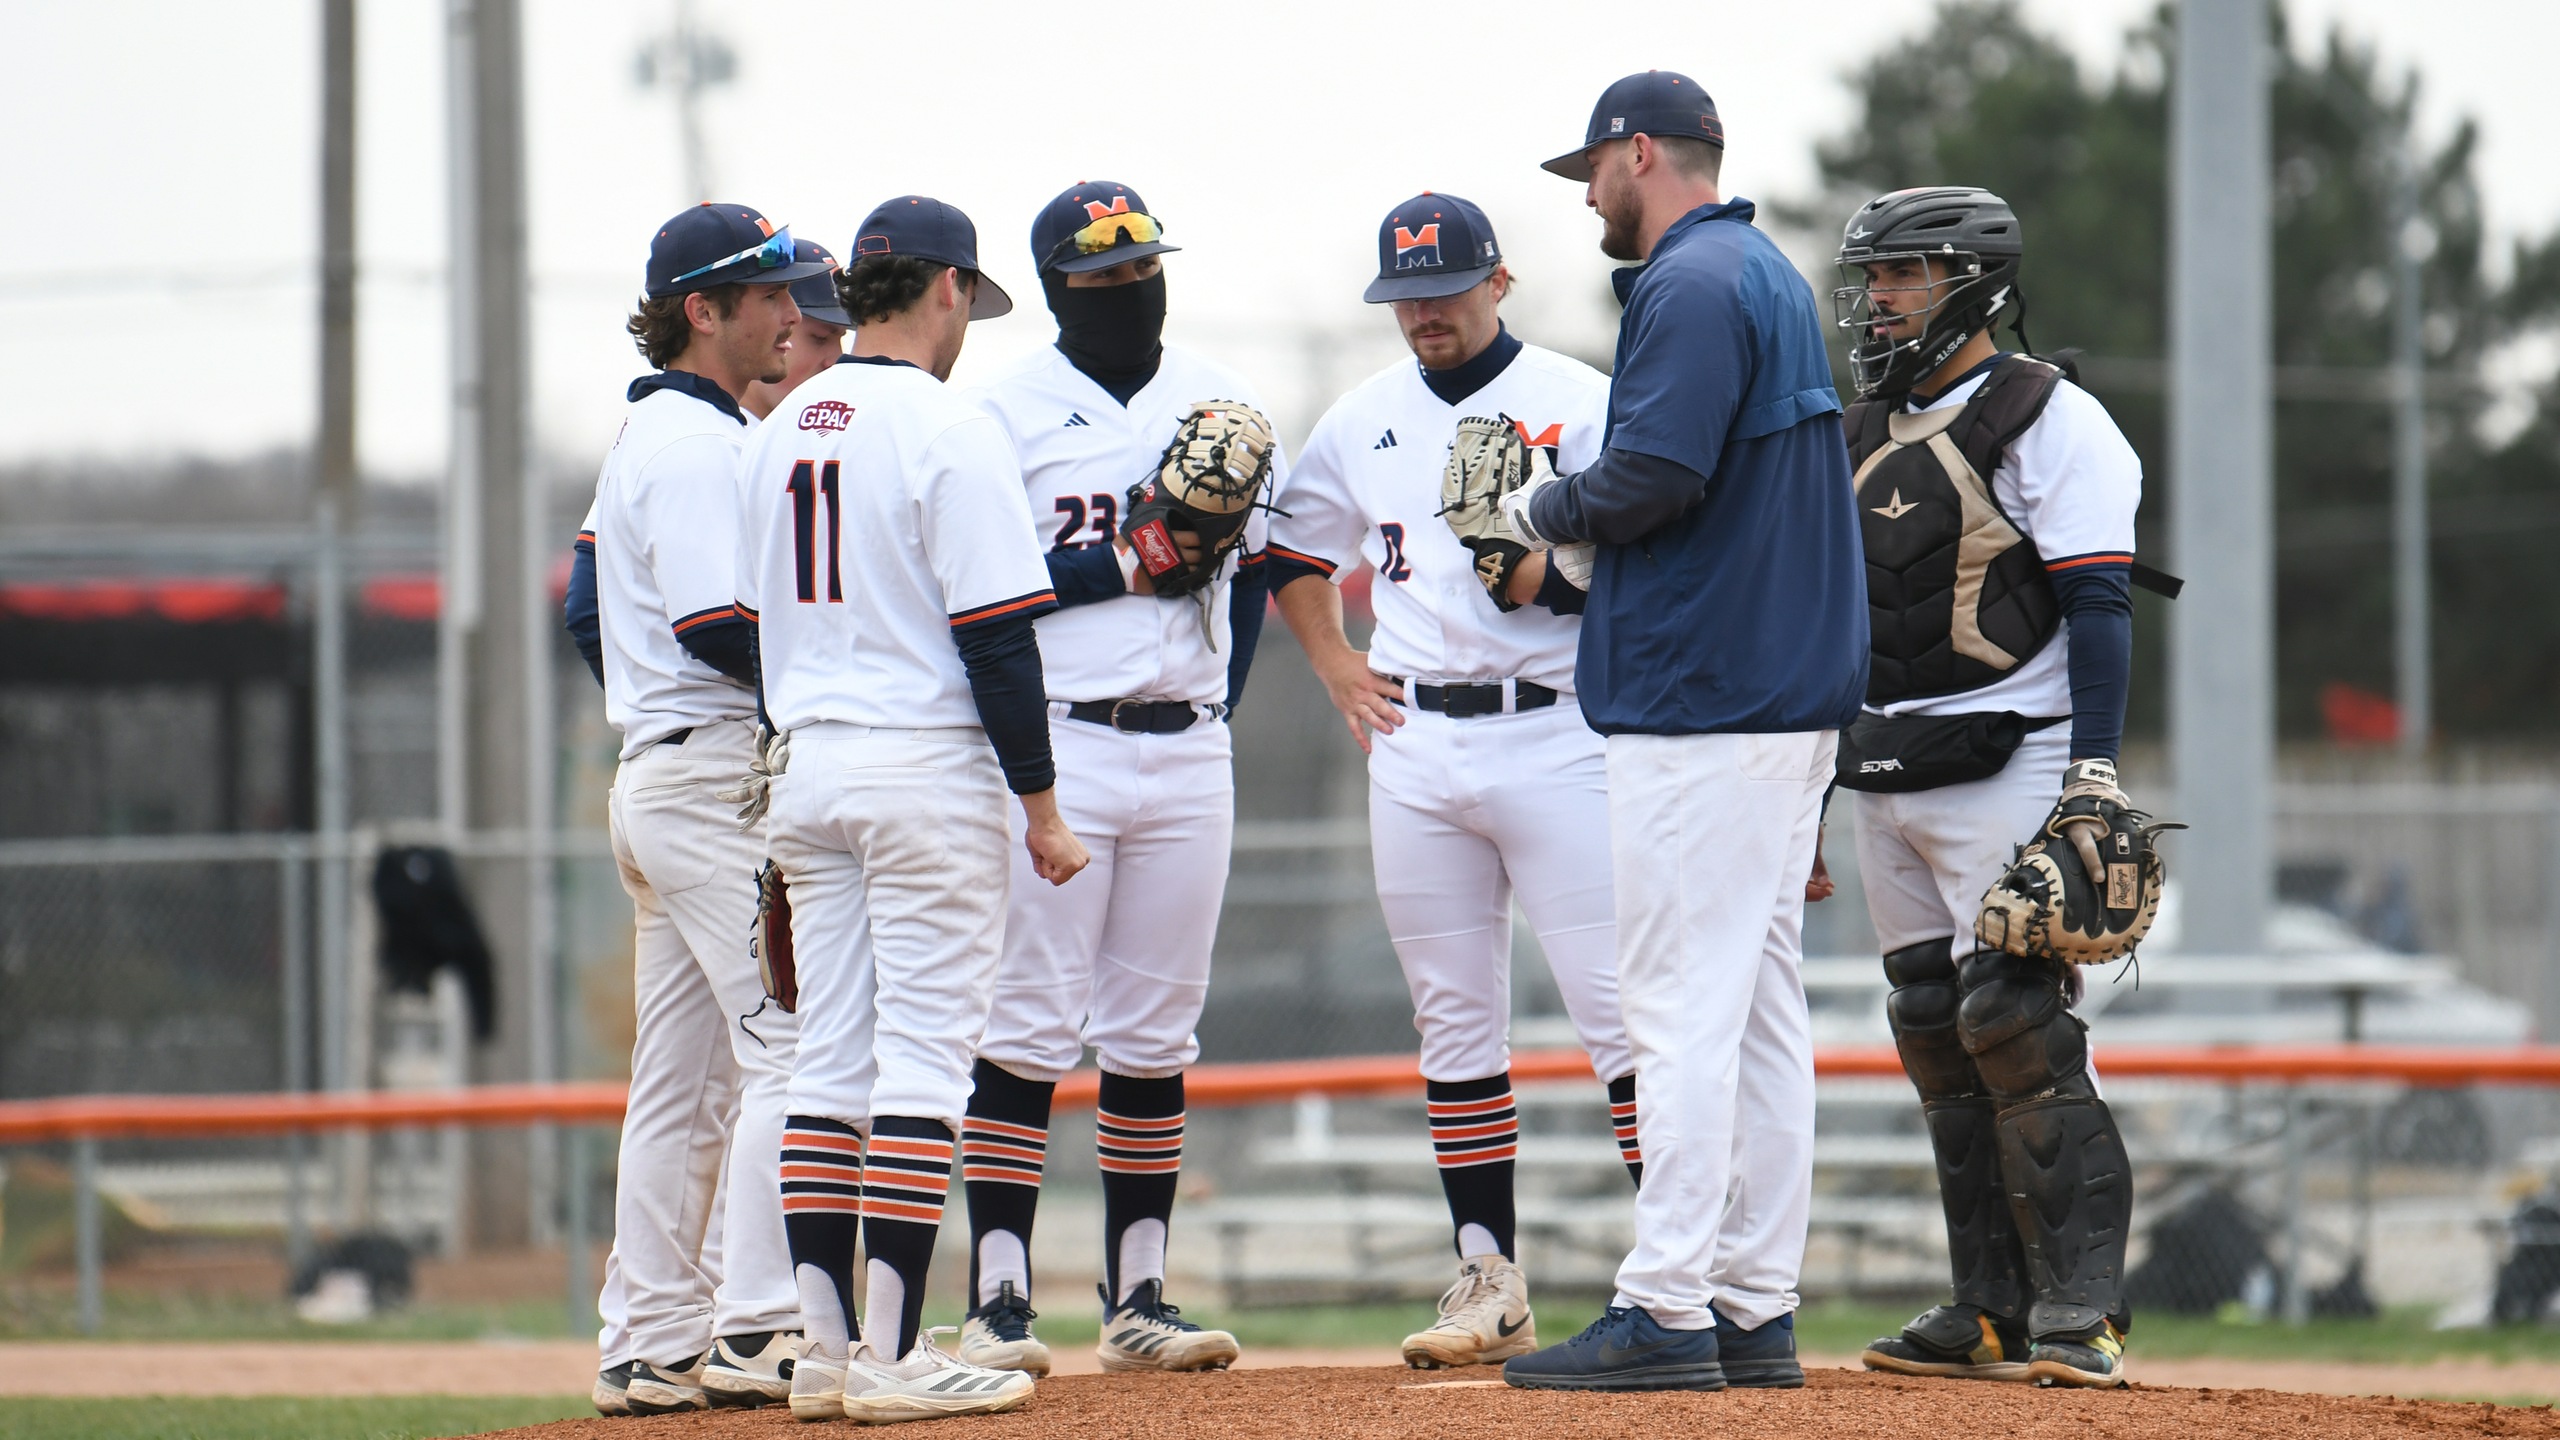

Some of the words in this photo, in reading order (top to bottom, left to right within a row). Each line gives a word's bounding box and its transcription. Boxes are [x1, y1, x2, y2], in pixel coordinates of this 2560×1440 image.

[1394, 223, 1443, 270] M
[800, 407, 853, 429] GPAC
[785, 459, 844, 603] 11
[1050, 493, 1117, 552] 23
[1141, 529, 1170, 566] Rawlings
